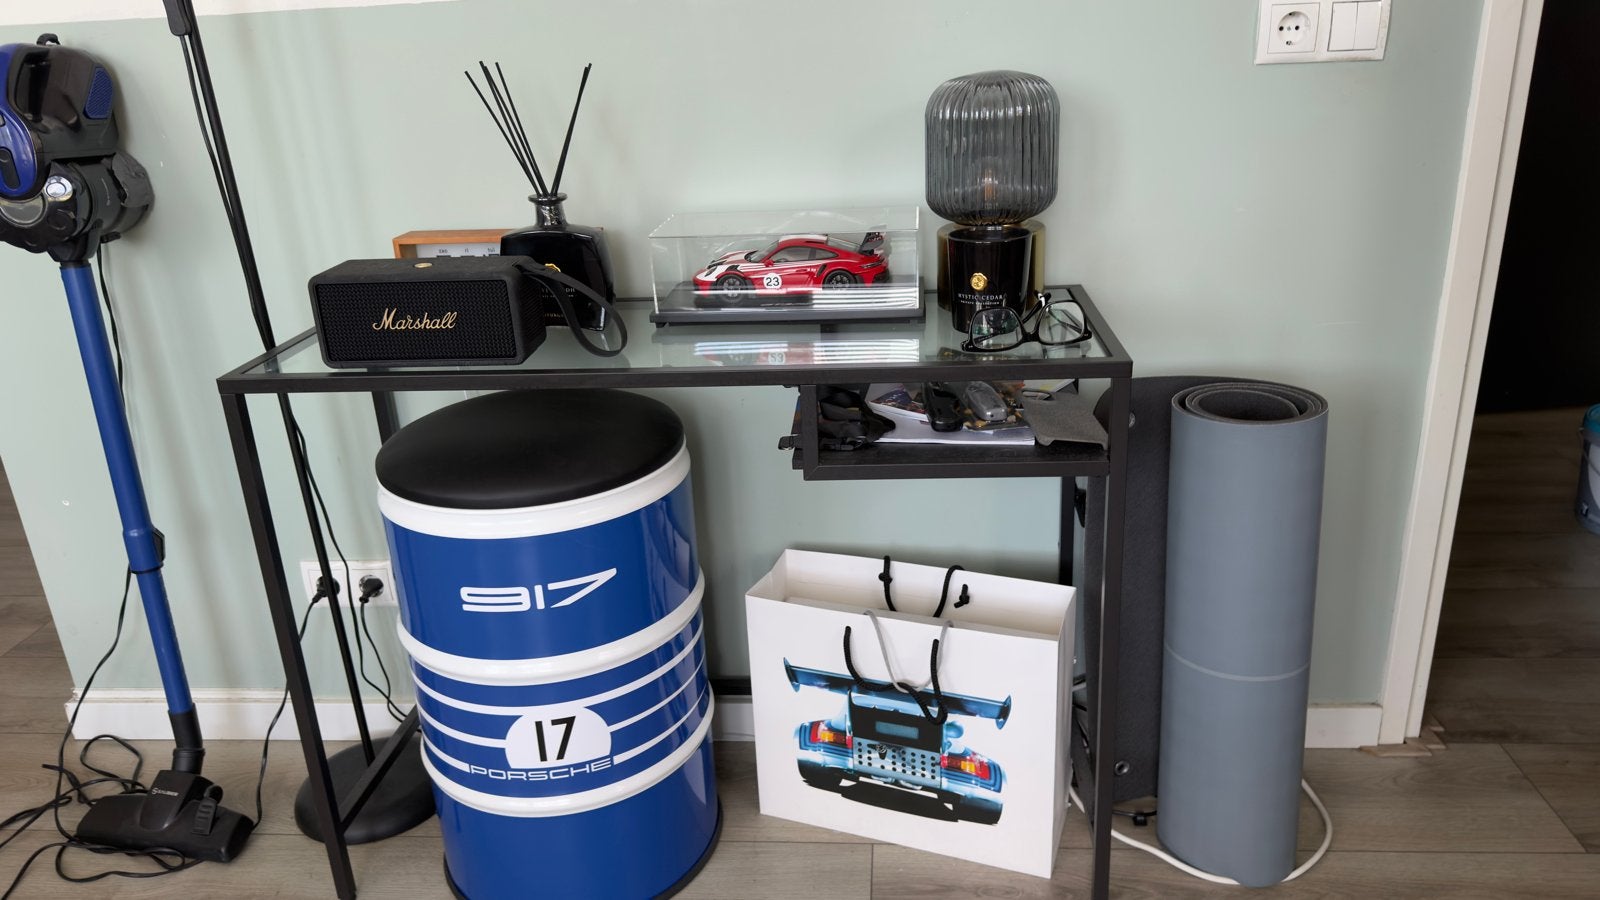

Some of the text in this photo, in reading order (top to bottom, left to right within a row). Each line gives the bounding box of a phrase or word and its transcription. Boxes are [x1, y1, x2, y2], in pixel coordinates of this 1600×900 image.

[765, 276, 780, 287] 23
[372, 307, 458, 331] Marshall
[460, 567, 618, 613] 917
[534, 715, 577, 763] 17
[469, 757, 613, 781] PORSCHE
